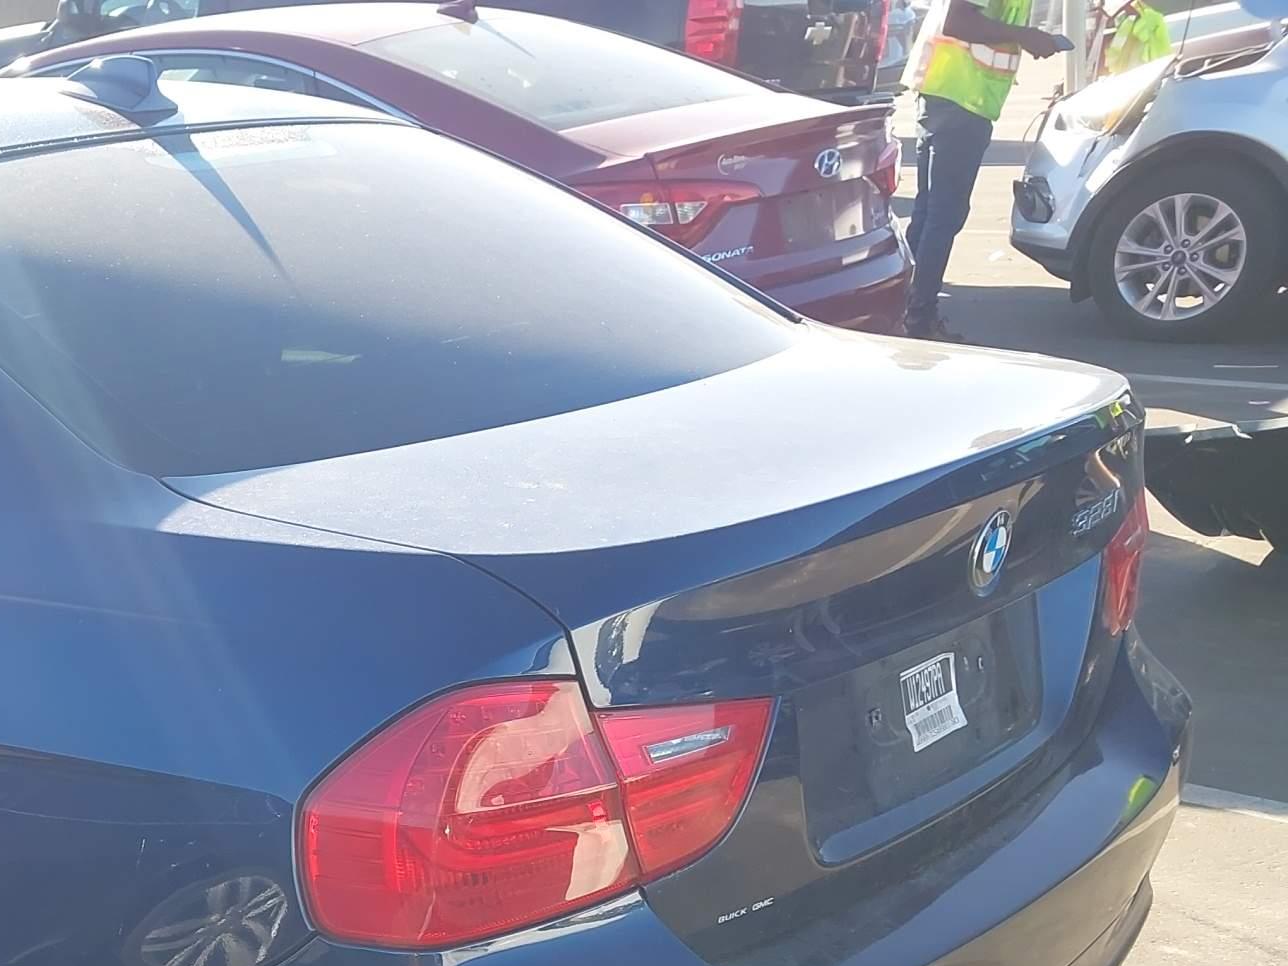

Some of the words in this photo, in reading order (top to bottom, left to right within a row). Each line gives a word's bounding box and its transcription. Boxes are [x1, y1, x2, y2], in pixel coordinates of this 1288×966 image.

[703, 246, 753, 262] SONATA
[718, 907, 748, 924] BUICK
[752, 897, 774, 911] GMC
